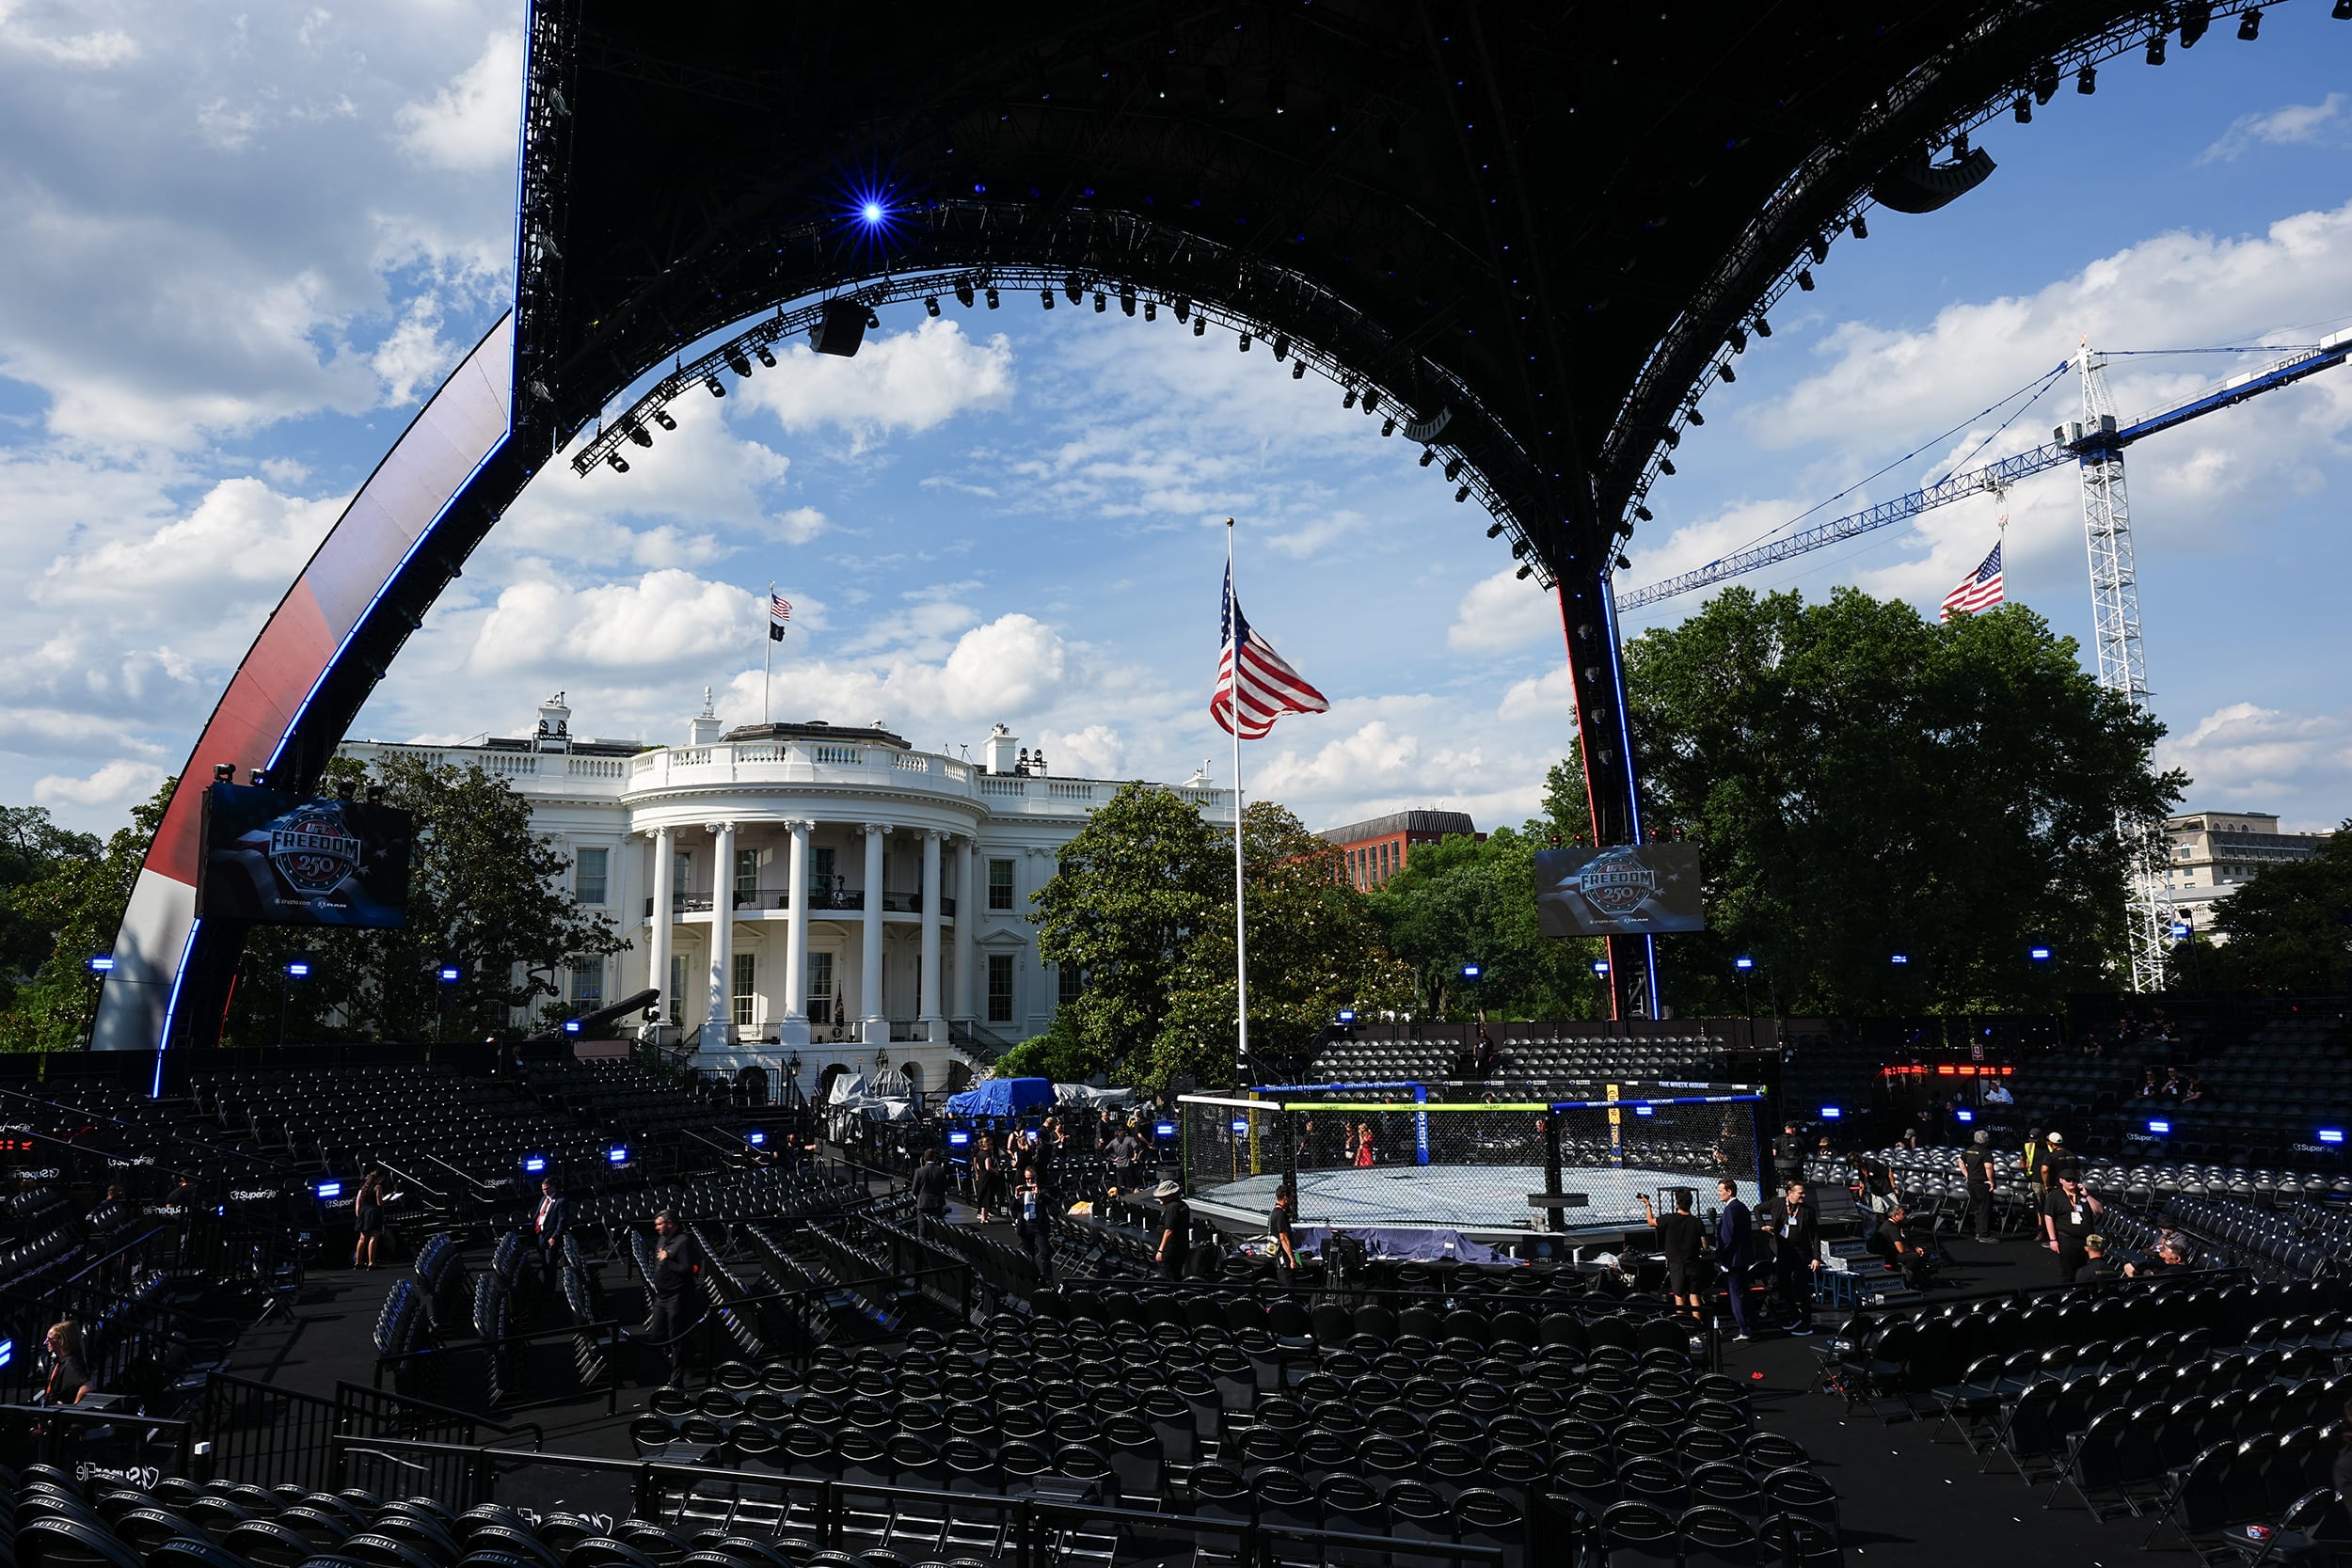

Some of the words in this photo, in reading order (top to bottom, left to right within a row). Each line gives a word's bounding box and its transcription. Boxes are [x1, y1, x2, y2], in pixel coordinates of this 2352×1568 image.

[272, 832, 358, 861] FREEDOM
[297, 855, 335, 877] 250
[1581, 873, 1653, 890] FREEDOM
[1604, 887, 1633, 902] 250
[239, 1190, 277, 1200] SuperFile
